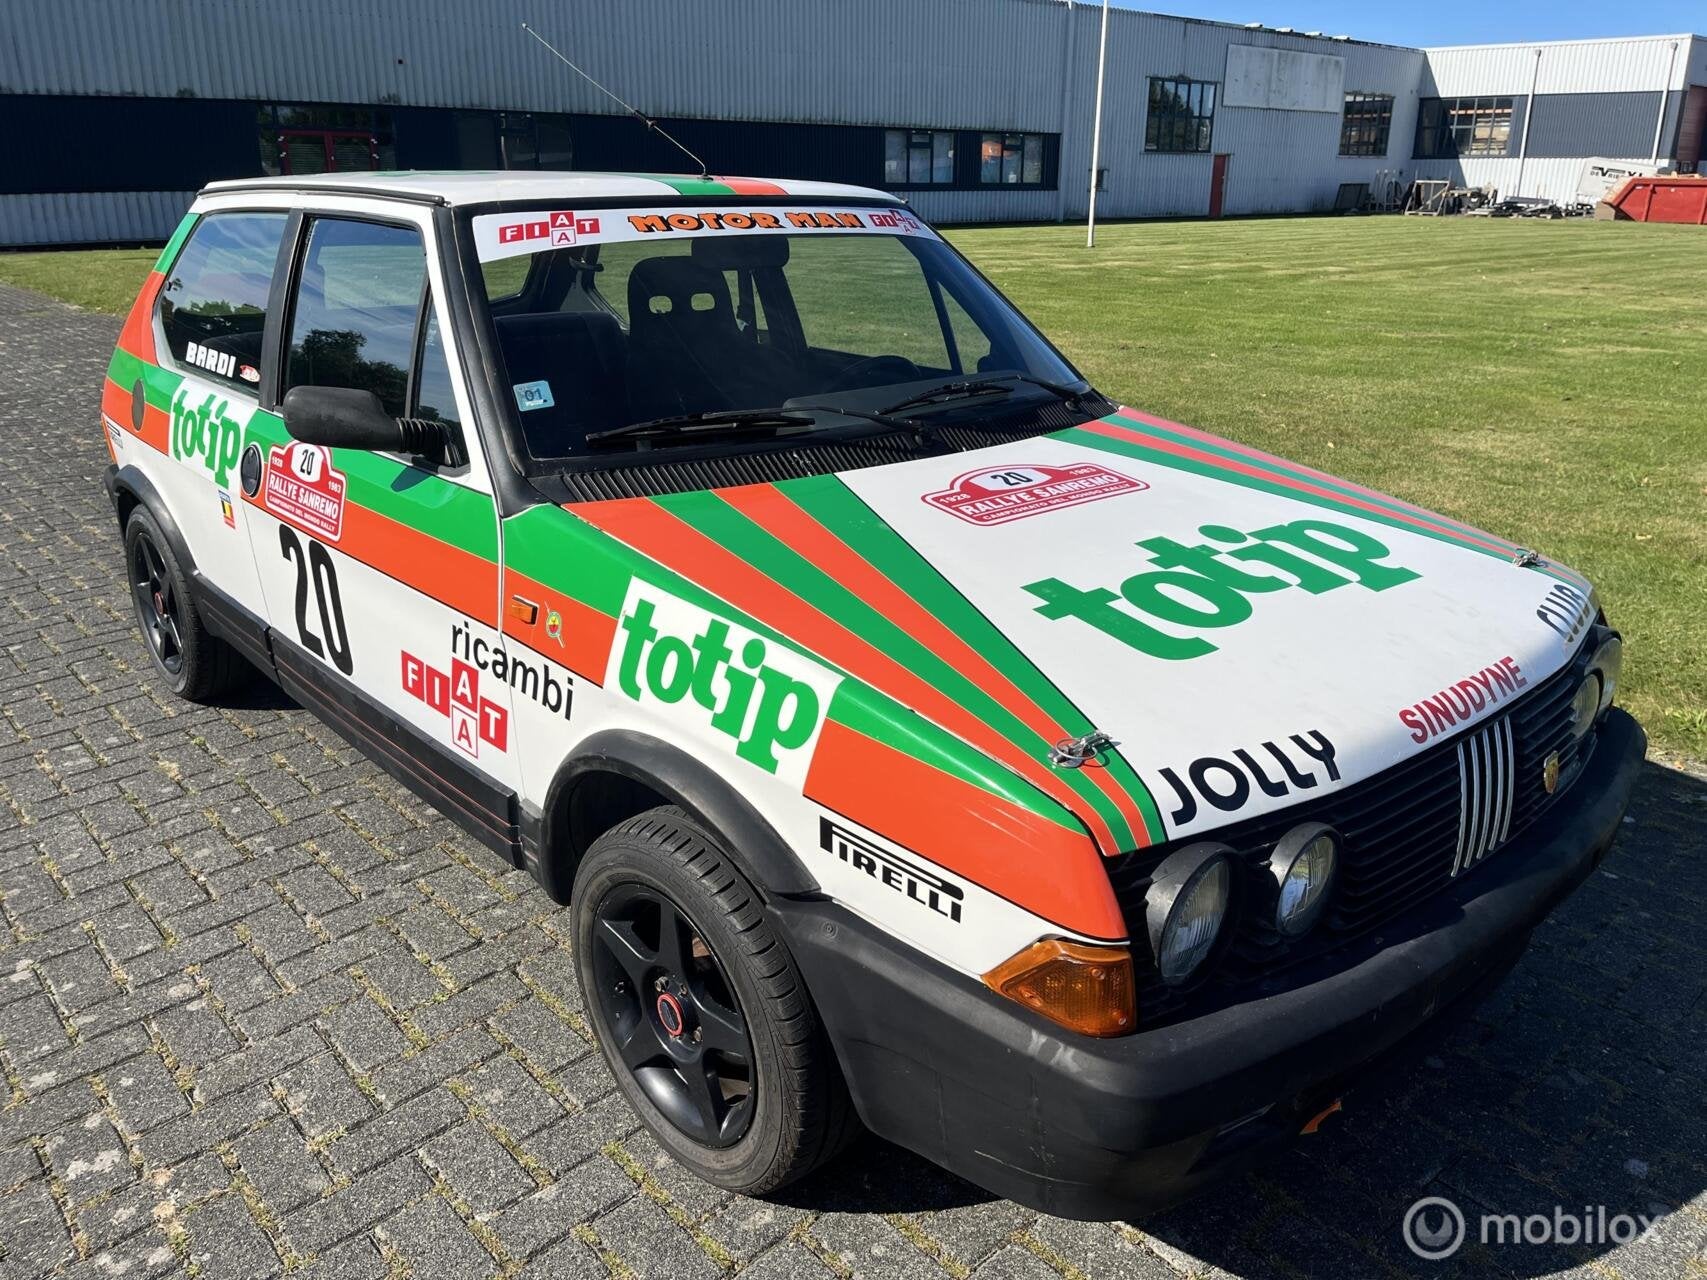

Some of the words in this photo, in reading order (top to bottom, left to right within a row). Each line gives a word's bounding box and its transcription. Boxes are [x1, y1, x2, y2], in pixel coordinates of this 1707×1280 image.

[503, 213, 596, 241] FIAT
[627, 212, 787, 233] MOTOR
[784, 212, 867, 229] MAN
[185, 341, 237, 378] BARDI
[171, 389, 241, 490] totip
[271, 456, 284, 468] 1928
[299, 449, 315, 476] 20
[990, 472, 1034, 488] 20
[1068, 466, 1097, 476] 1983
[269, 473, 299, 500] RALLYE
[298, 487, 339, 520] SANREMO
[328, 480, 342, 493] 1983
[938, 492, 971, 504] 1928
[959, 491, 1036, 516] RALLYE
[1036, 473, 1122, 499] SANREMO
[982, 500, 1048, 521] CAMPIONATO
[279, 524, 354, 676] 20
[1020, 519, 1423, 661] totip
[452, 620, 573, 721] ricambi
[619, 597, 819, 775] totip
[404, 654, 505, 748] FIAT
[1397, 656, 1528, 745] SINUDYNE
[1158, 730, 1342, 827] JOLLY
[819, 815, 964, 923] PIRELLI
